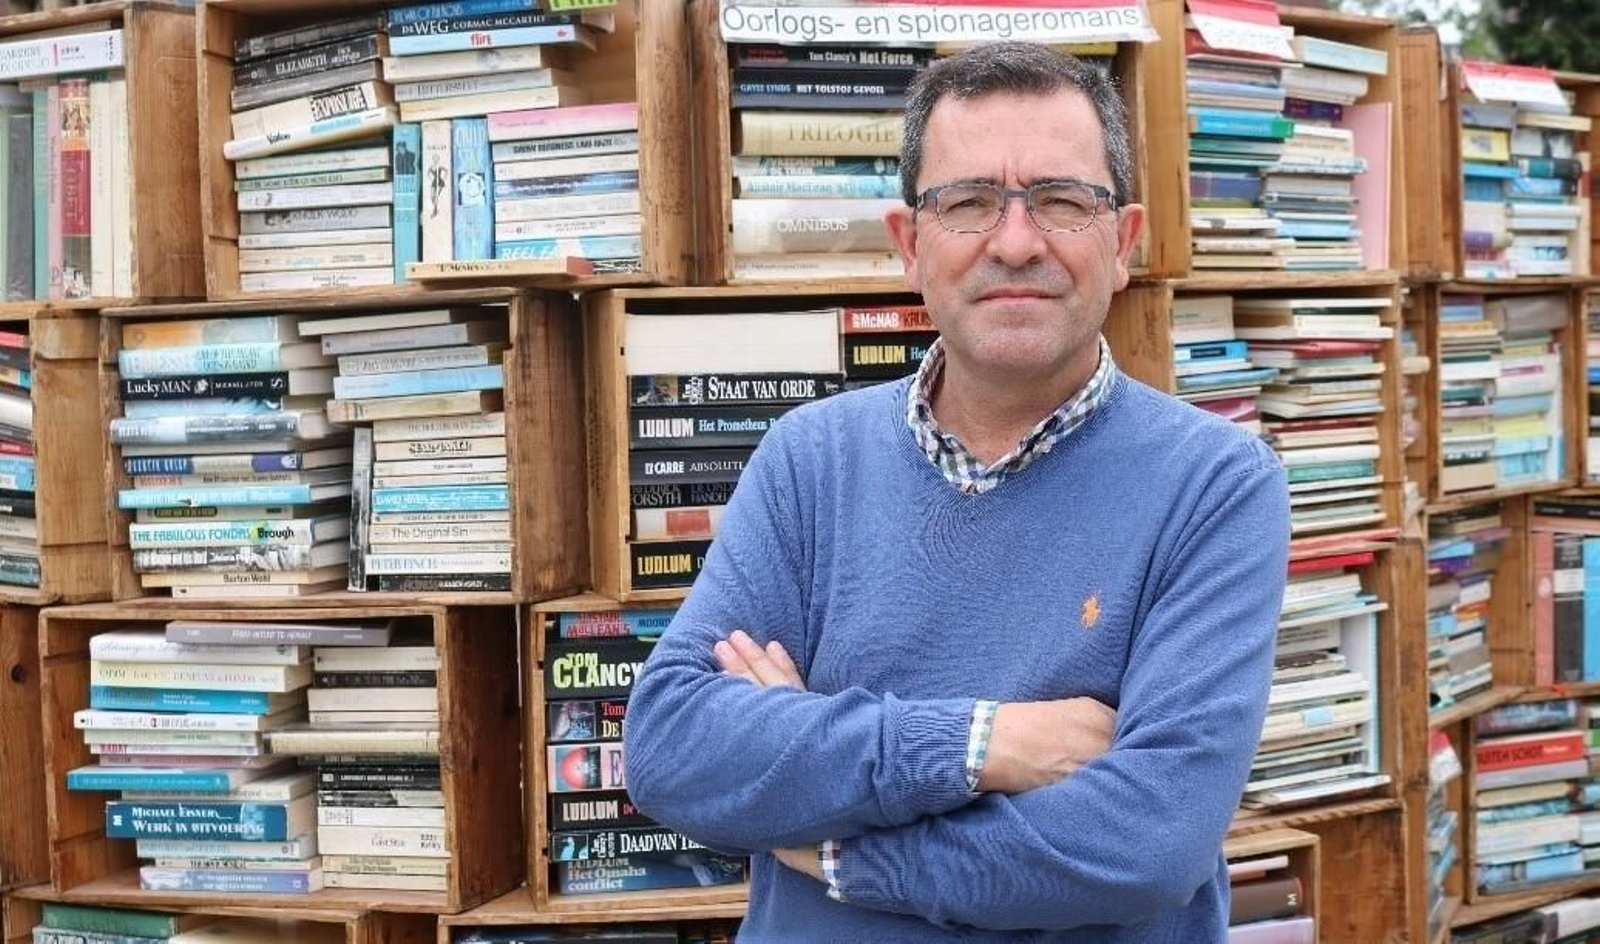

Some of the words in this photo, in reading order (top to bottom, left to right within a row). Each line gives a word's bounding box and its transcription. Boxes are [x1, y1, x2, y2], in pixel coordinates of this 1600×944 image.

[415, 19, 449, 35] WEG
[452, 18, 493, 31] CORMAC
[495, 14, 546, 26] MCCARTHY
[723, 6, 844, 41] Oorlogs-
[855, 14, 890, 35] en
[898, 7, 1140, 38] spionageromans
[470, 30, 492, 47] flirt
[275, 54, 328, 75] ELIZABETH
[809, 52, 824, 61] Tom
[825, 52, 856, 65] Clancy's
[859, 51, 880, 64] Net
[881, 52, 914, 65] Force
[796, 84, 812, 94] HET
[788, 124, 896, 143] TRILOGIE
[777, 218, 849, 233] OMNIBUS
[860, 312, 900, 329] McNAB
[853, 345, 906, 365] LUDLUM
[708, 376, 749, 400] STAAT
[752, 380, 778, 399] VAN
[781, 379, 816, 398] ORDE
[639, 418, 694, 438] LUDLUM
[699, 420, 715, 432] Het
[717, 418, 767, 432] Prometheus
[632, 493, 682, 506] ORSYTH
[133, 530, 151, 541] THE
[153, 529, 206, 542] FABULOUS
[208, 529, 251, 540] FONDAS
[257, 527, 295, 539] Brough
[392, 528, 412, 539] The
[413, 528, 451, 543] Original
[451, 526, 469, 537] Sin
[637, 554, 693, 576] LUDLUM
[638, 617, 671, 628] MOORD
[567, 652, 599, 668] TOM
[552, 654, 645, 689] CLANCY
[602, 702, 624, 716] Tom
[602, 719, 620, 738] DE
[132, 806, 175, 819] MICHAEL
[178, 804, 211, 819] EISNER
[562, 800, 619, 821] LUDLUM
[132, 820, 172, 833] WERK
[175, 821, 188, 833] IN
[191, 821, 265, 834] UITVOERING
[620, 833, 653, 854] DAAD
[653, 833, 677, 851] VAN
[568, 869, 594, 881] Het
[594, 865, 646, 880] Omaha
[568, 878, 623, 891] conflict
